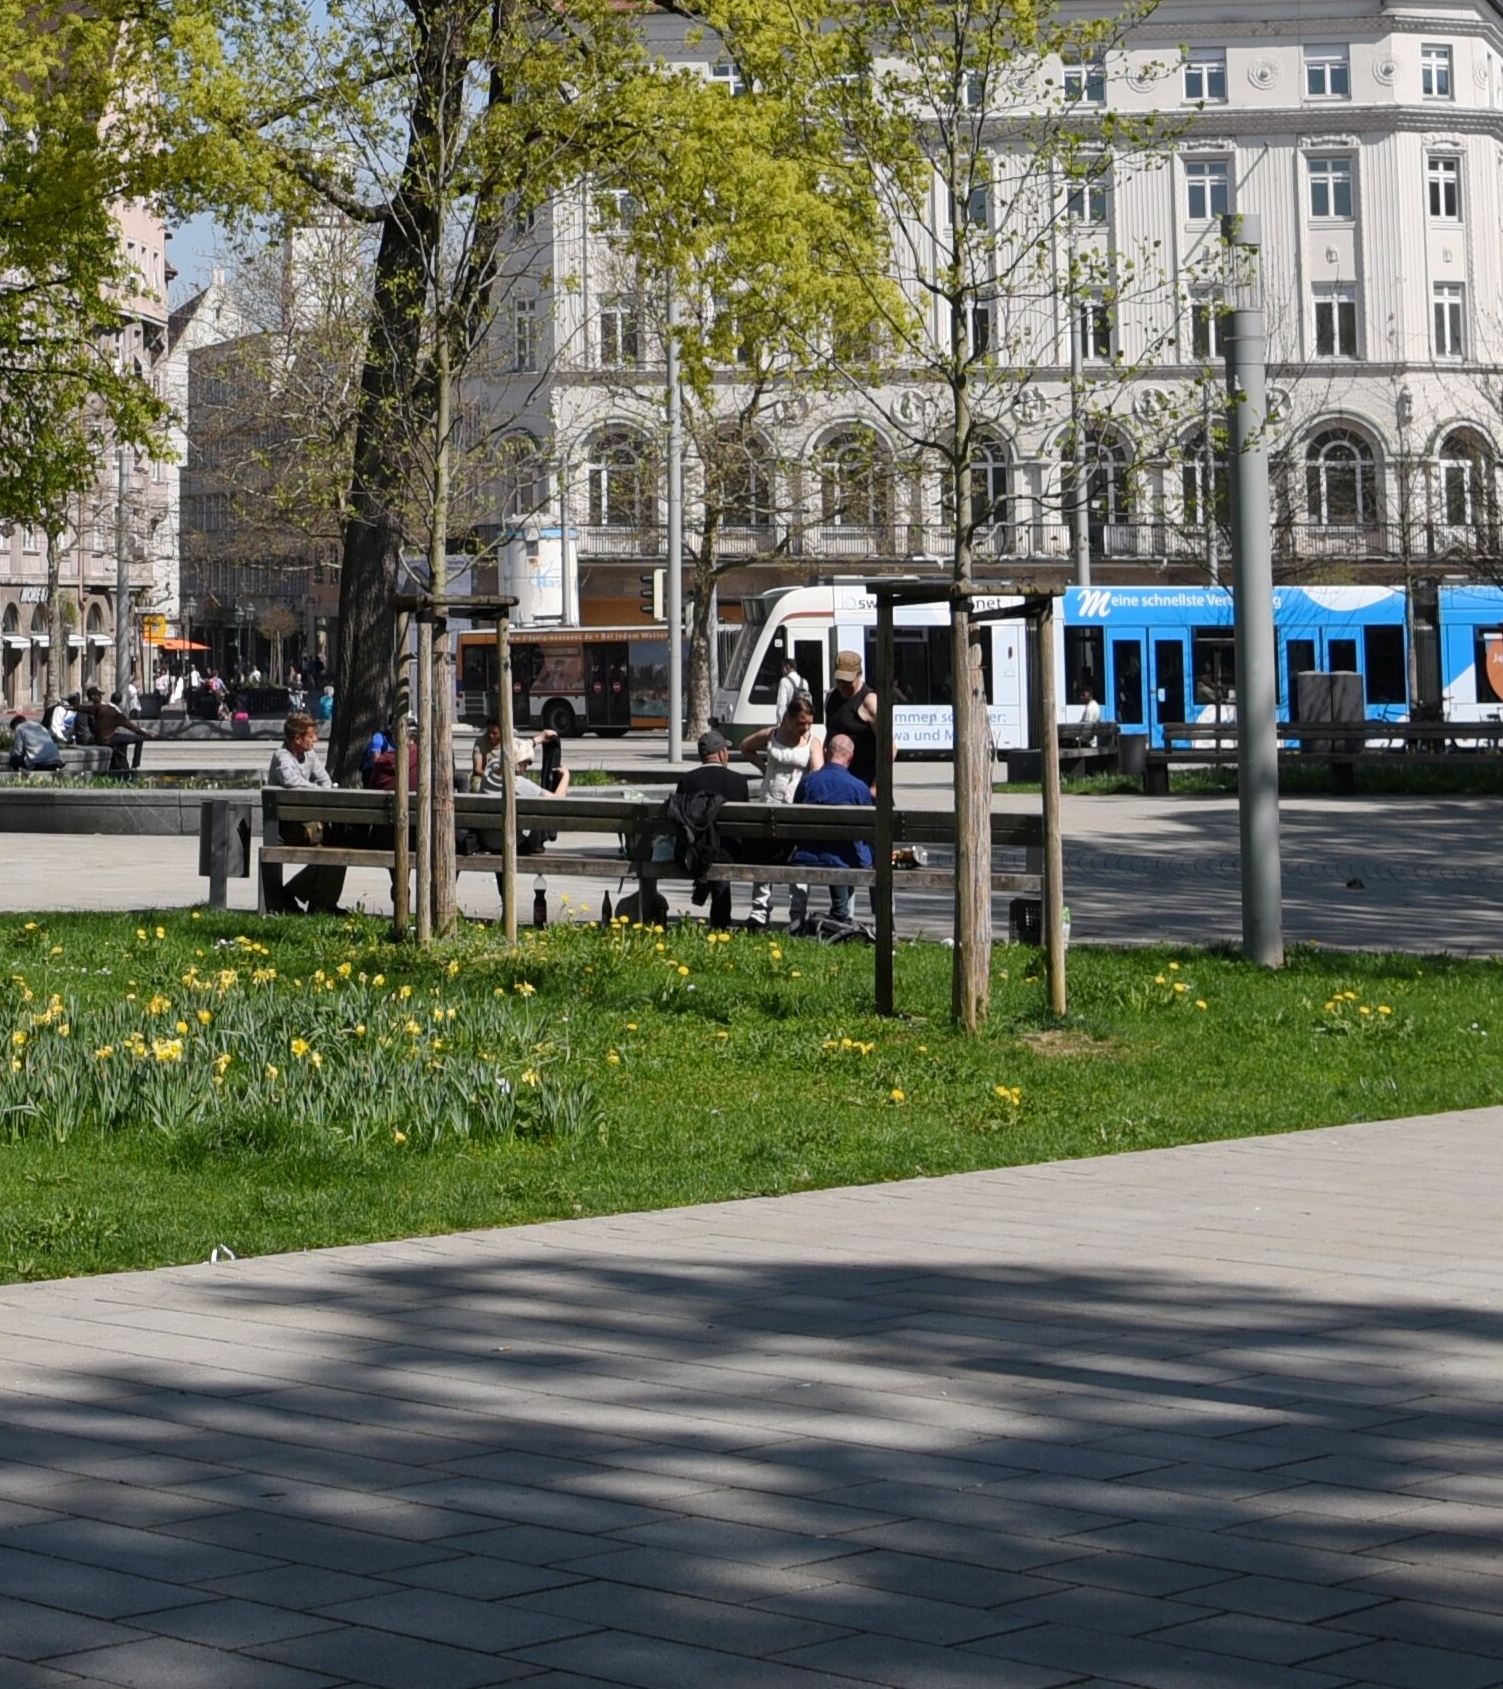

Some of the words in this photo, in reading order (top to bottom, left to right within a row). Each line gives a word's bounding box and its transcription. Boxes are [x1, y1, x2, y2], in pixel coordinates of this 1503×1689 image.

[858, 599, 877, 609] sw
[976, 597, 1003, 609] net
[1077, 589, 1139, 618] Meine
[1142, 593, 1205, 607] schnellste
[1206, 593, 1282, 609] Verbg
[895, 713, 938, 723] mmen
[893, 732, 909, 741] wa
[914, 730, 940, 741] und
